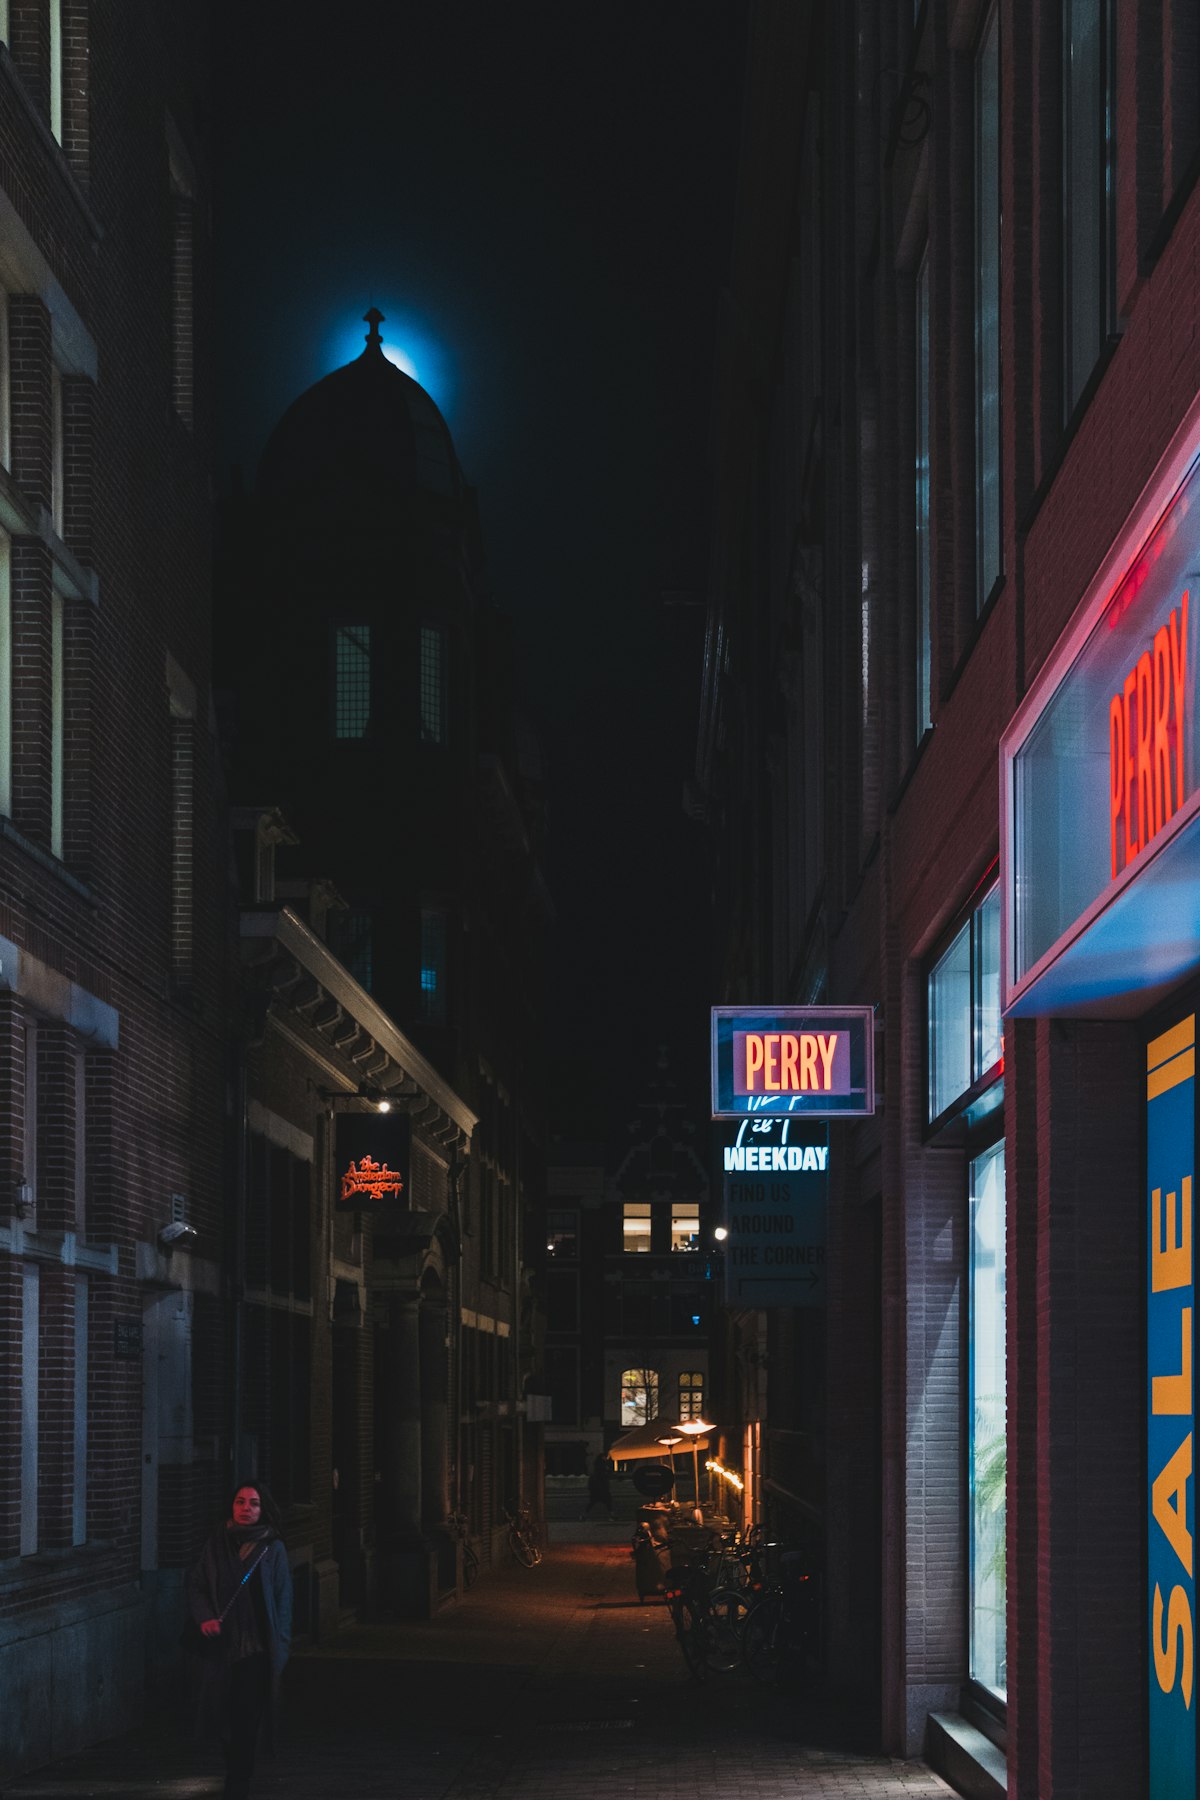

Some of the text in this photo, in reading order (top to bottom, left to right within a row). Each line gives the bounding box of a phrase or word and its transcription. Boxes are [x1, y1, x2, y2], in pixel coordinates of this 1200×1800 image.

[1110, 589, 1189, 880] PERRY
[746, 1034, 837, 1091] PERRY
[724, 1146, 828, 1171] WEEKDAY
[344, 1161, 402, 1182] Amsterdam
[340, 1177, 404, 1200] Dungeon
[730, 1184, 791, 1202] FIND US
[732, 1215, 795, 1234] AROUND
[732, 1247, 826, 1265] THE CORNER
[1151, 1174, 1194, 1712] SALE
